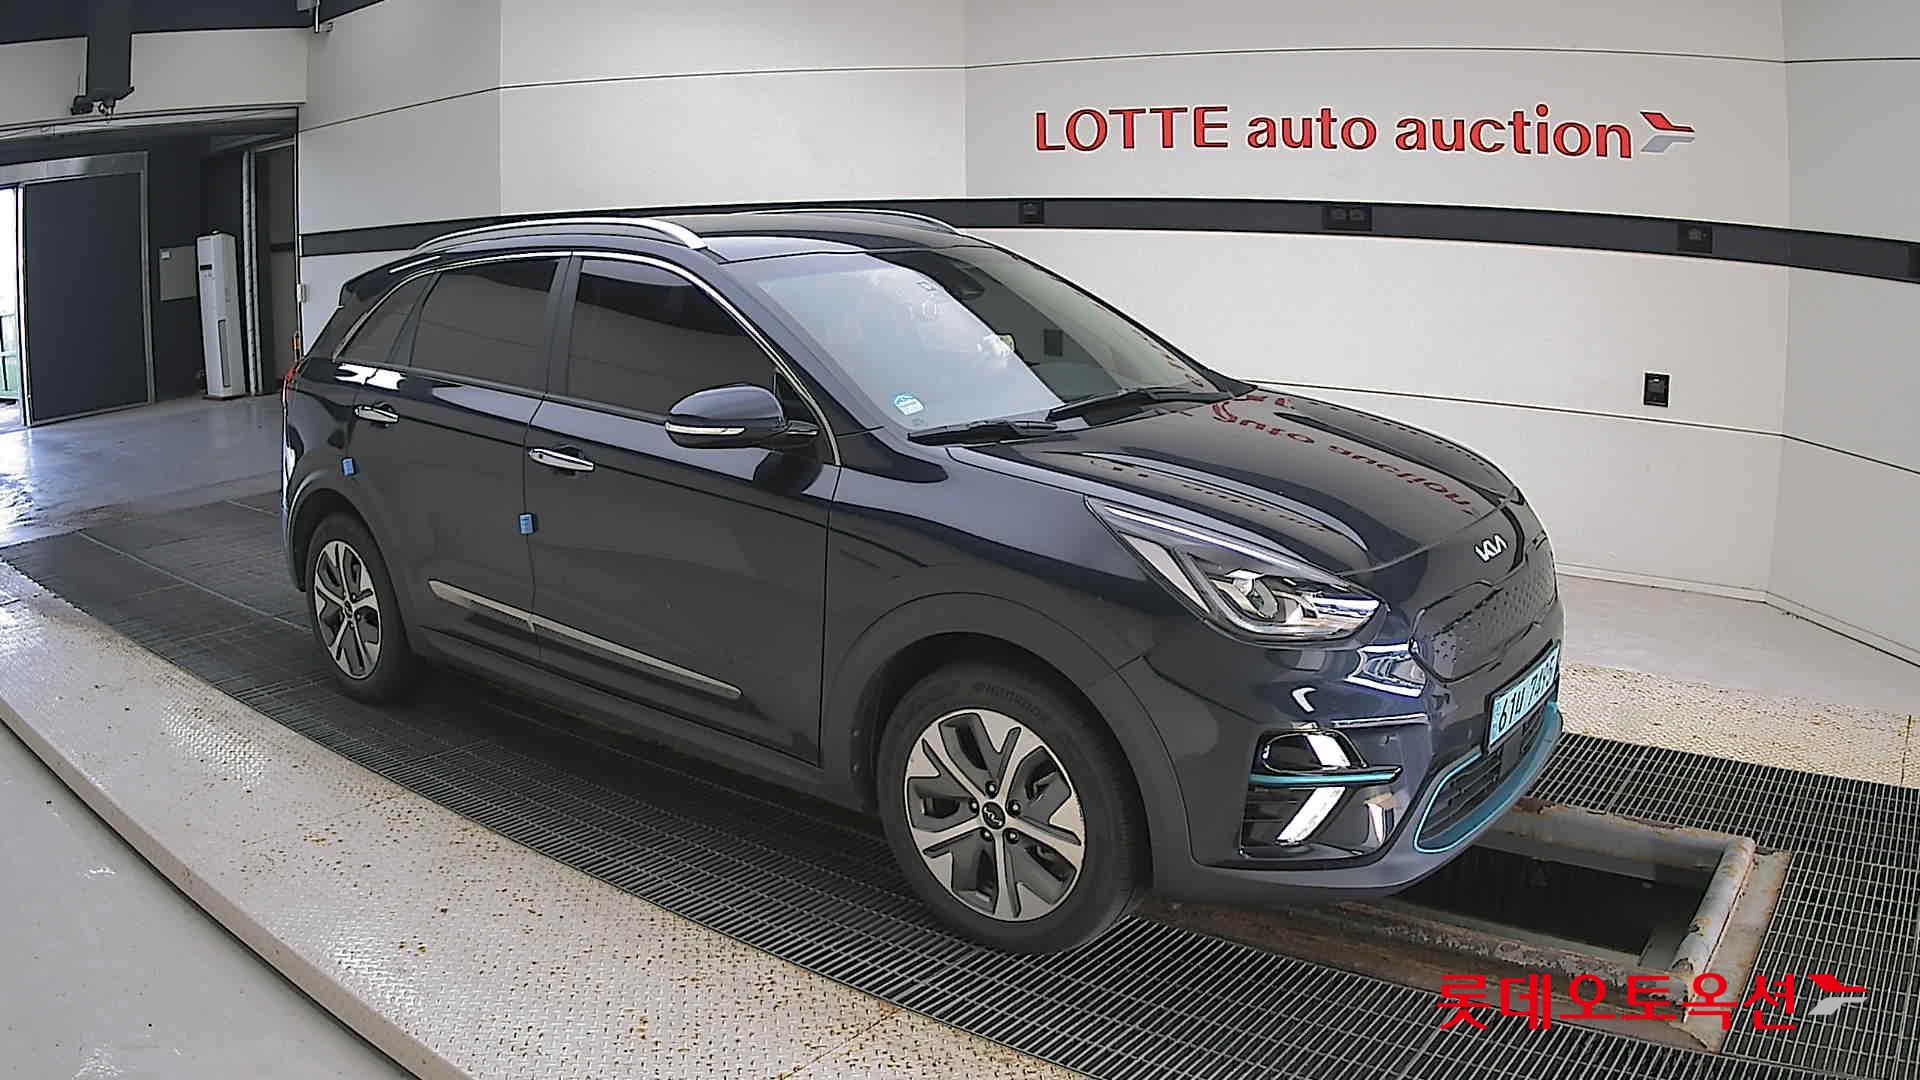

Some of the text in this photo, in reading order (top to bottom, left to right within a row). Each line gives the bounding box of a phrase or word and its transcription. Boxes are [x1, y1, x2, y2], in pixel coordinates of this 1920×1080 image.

[1036, 104, 1632, 158] LOTTE auto auction
